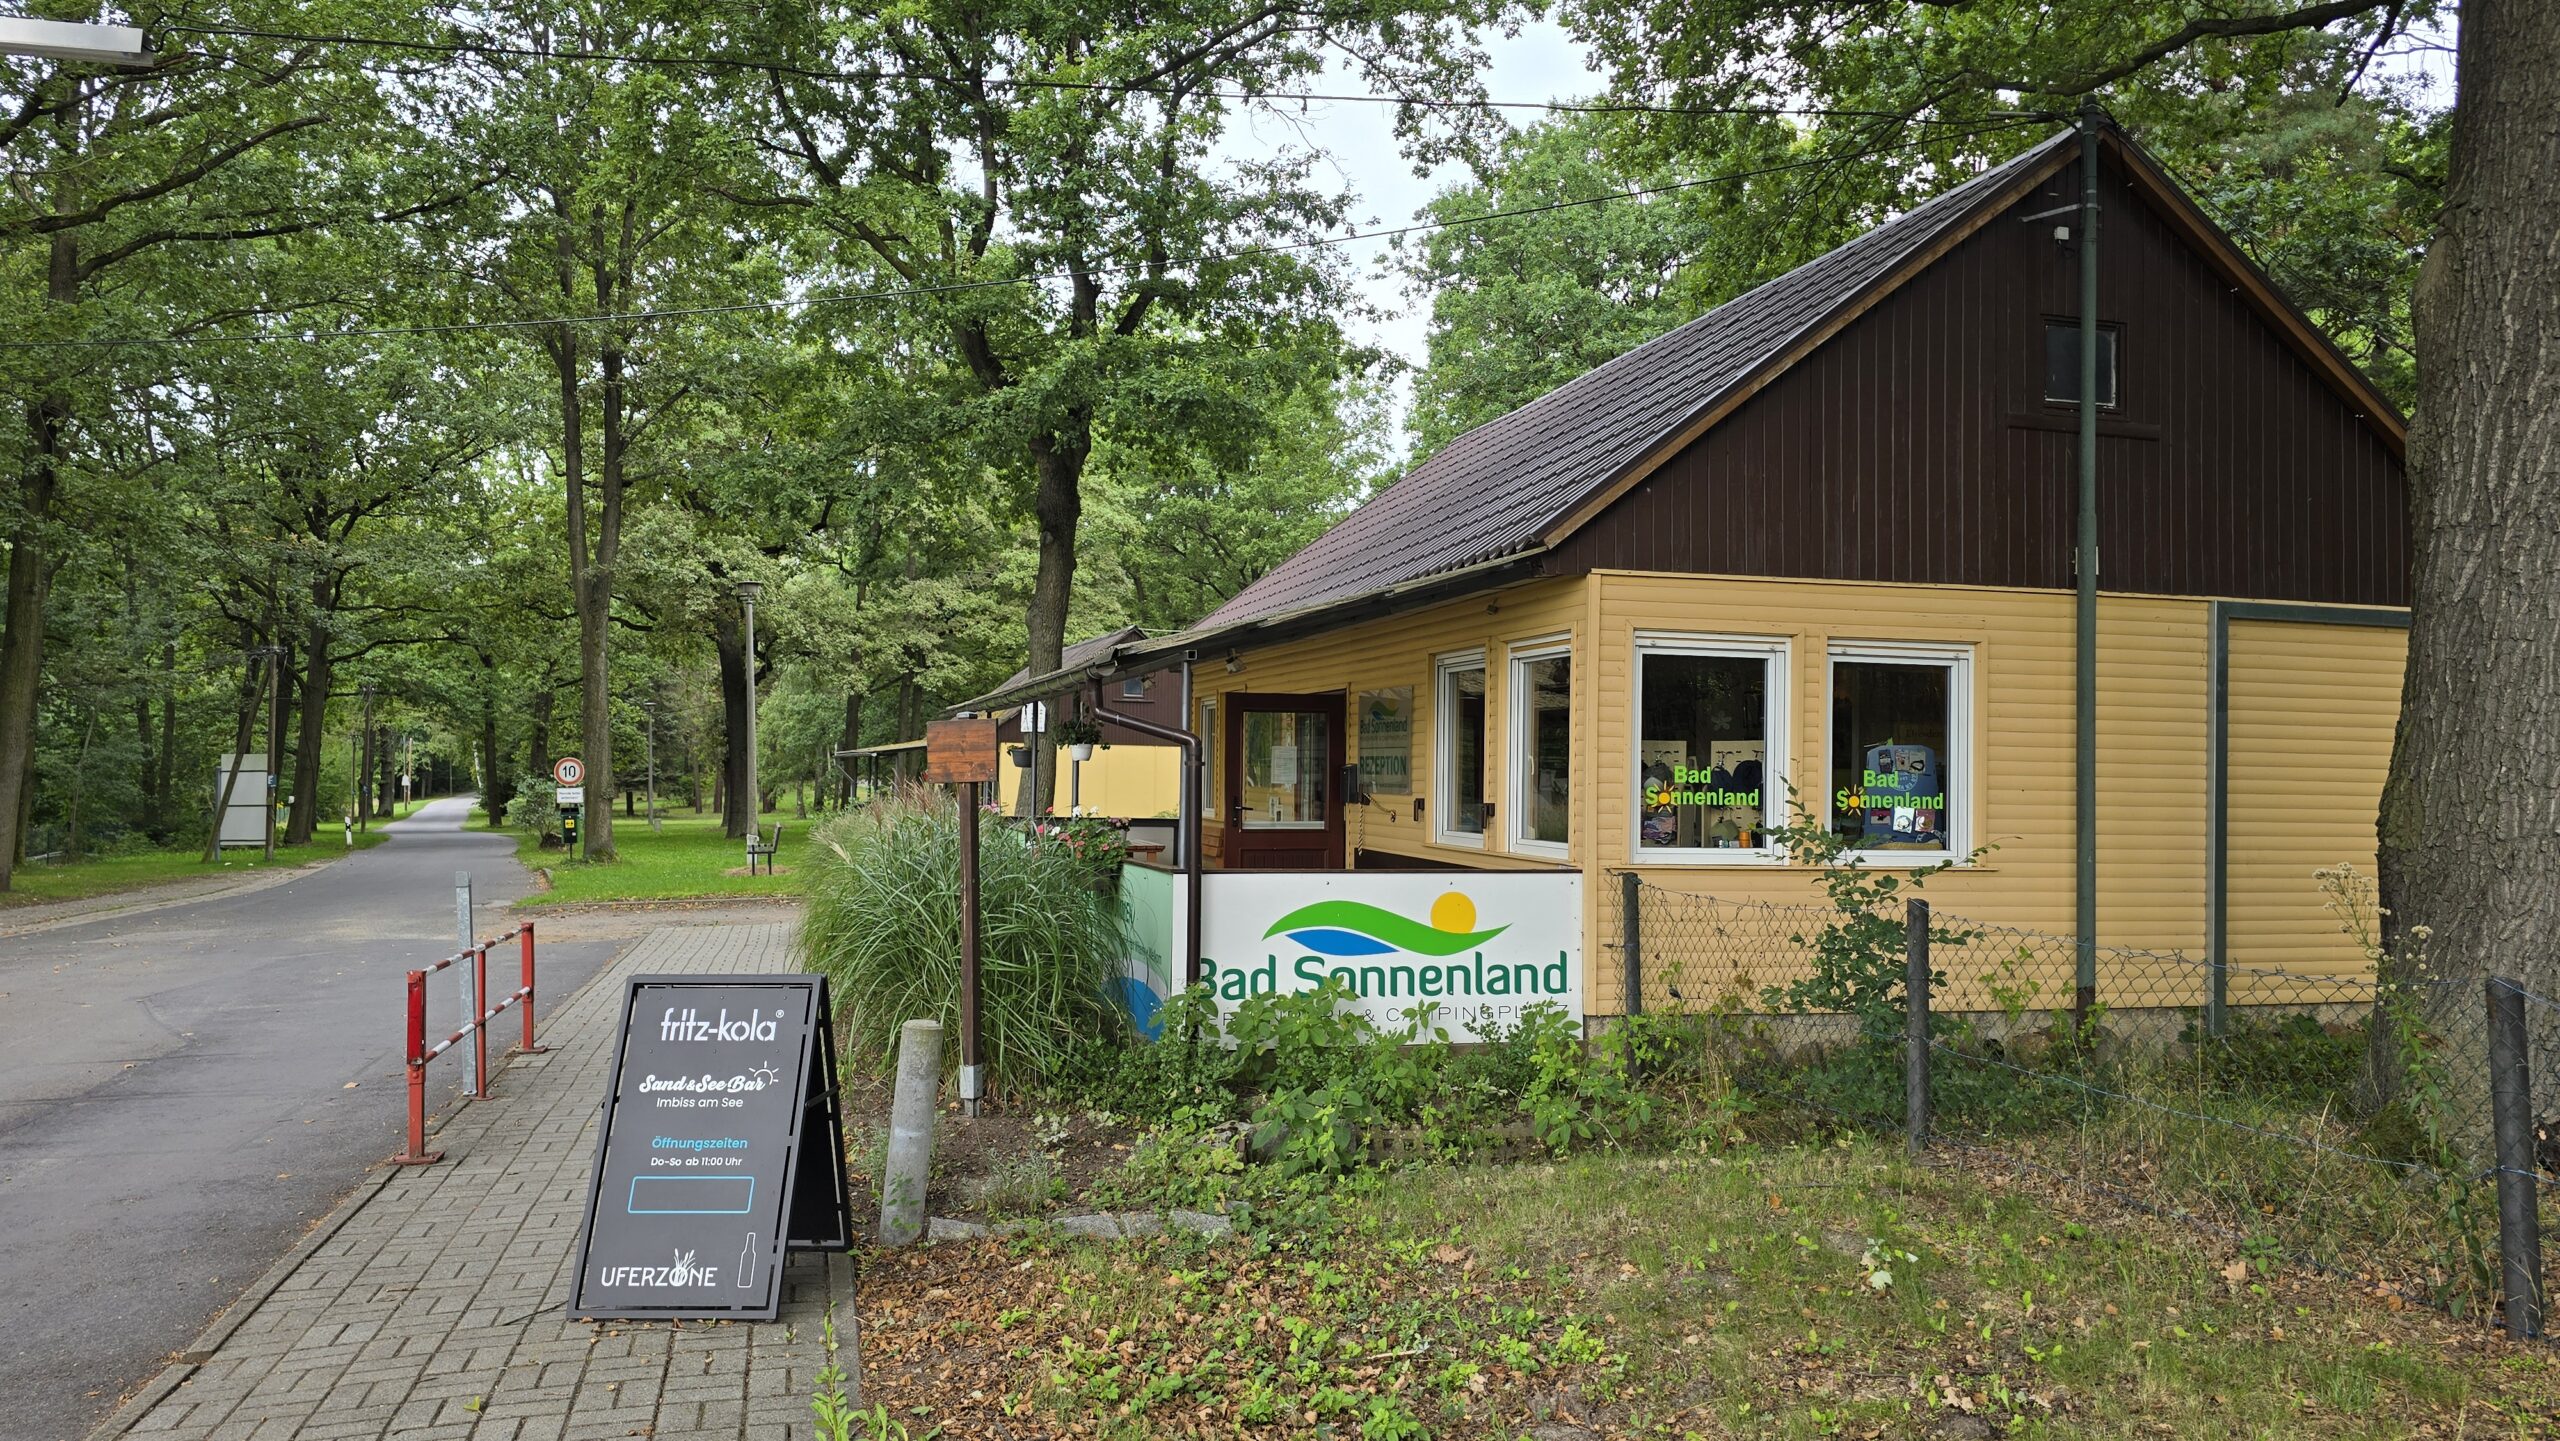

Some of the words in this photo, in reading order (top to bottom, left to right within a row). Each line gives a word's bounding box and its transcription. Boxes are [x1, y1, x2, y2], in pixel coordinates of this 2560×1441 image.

[562, 765, 576, 778] 10
[1359, 755, 1407, 776] REZEPTION
[1673, 765, 1712, 784] Bad
[1863, 769, 1899, 788] Bad
[1294, 951, 1568, 1001] Sonnenland
[656, 1097, 695, 1108] Imbiss
[698, 1099, 718, 1108] am
[721, 1097, 744, 1108] See
[652, 1135, 748, 1152] Öffnungszeiten
[651, 1157, 682, 1166] Do-So
[686, 1157, 699, 1166] ab
[701, 1157, 723, 1166] 11:00
[725, 1157, 743, 1166] Uhr
[601, 1266, 718, 1287] UFERZONE
